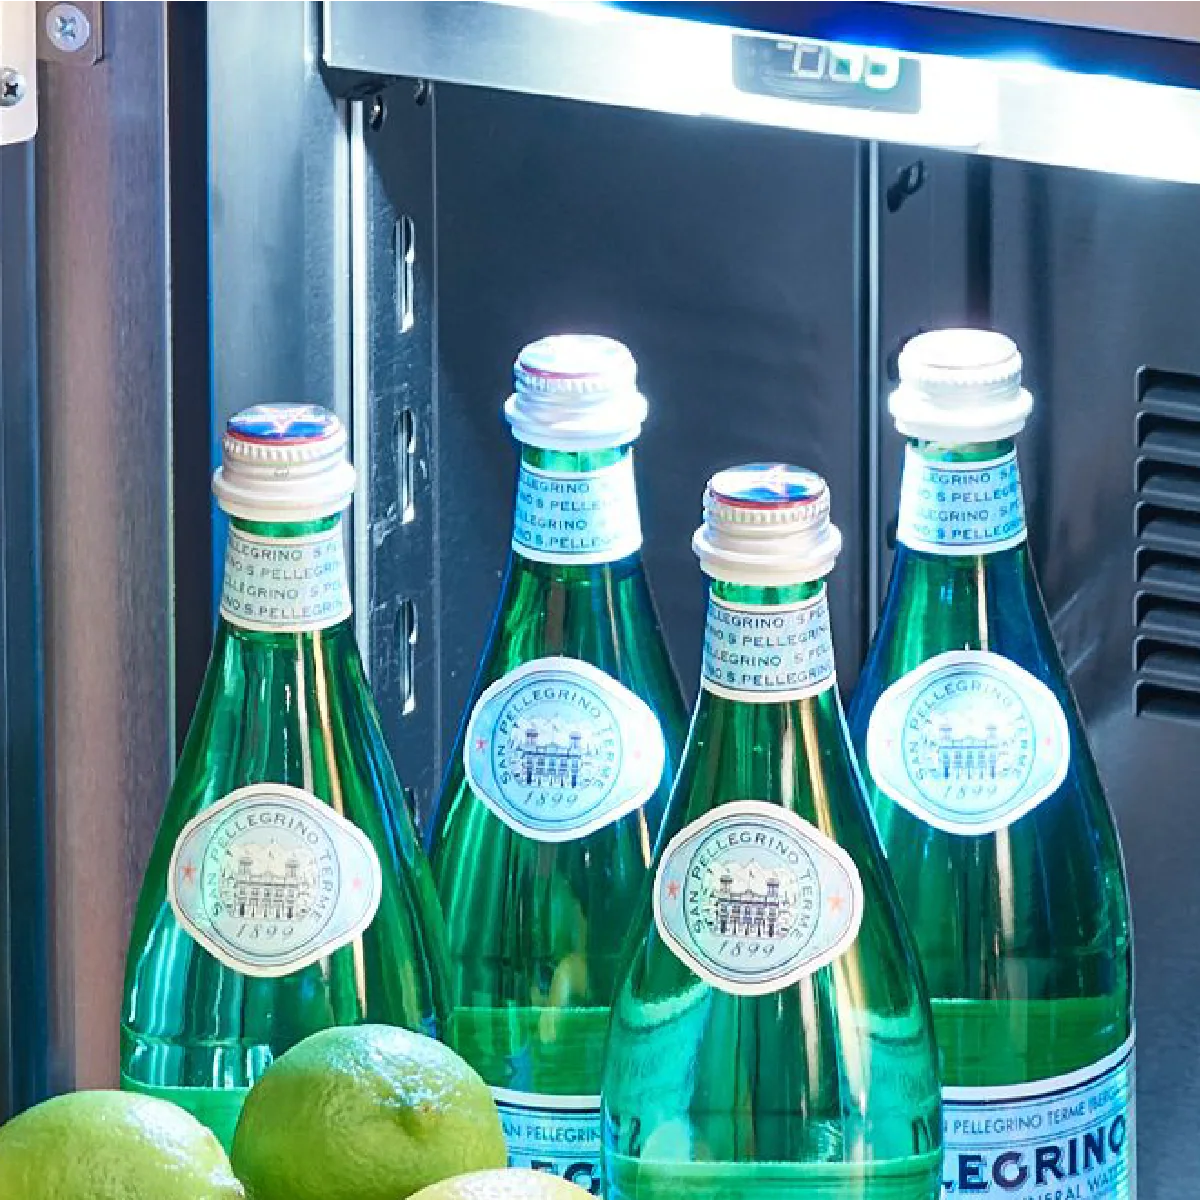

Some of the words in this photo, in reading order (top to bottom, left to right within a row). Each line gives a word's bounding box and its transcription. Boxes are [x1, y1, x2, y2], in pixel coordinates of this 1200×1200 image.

[499, 687, 602, 735] PELLEGRINO
[910, 679, 1013, 730] PELLEGRINO
[210, 811, 320, 863] PELLEGRINO
[691, 830, 800, 881] PELLEGRINO
[689, 890, 702, 935] SAN
[953, 1114, 1043, 1136] PELLEGRINO
[942, 1114, 1126, 1191] EGRINO
